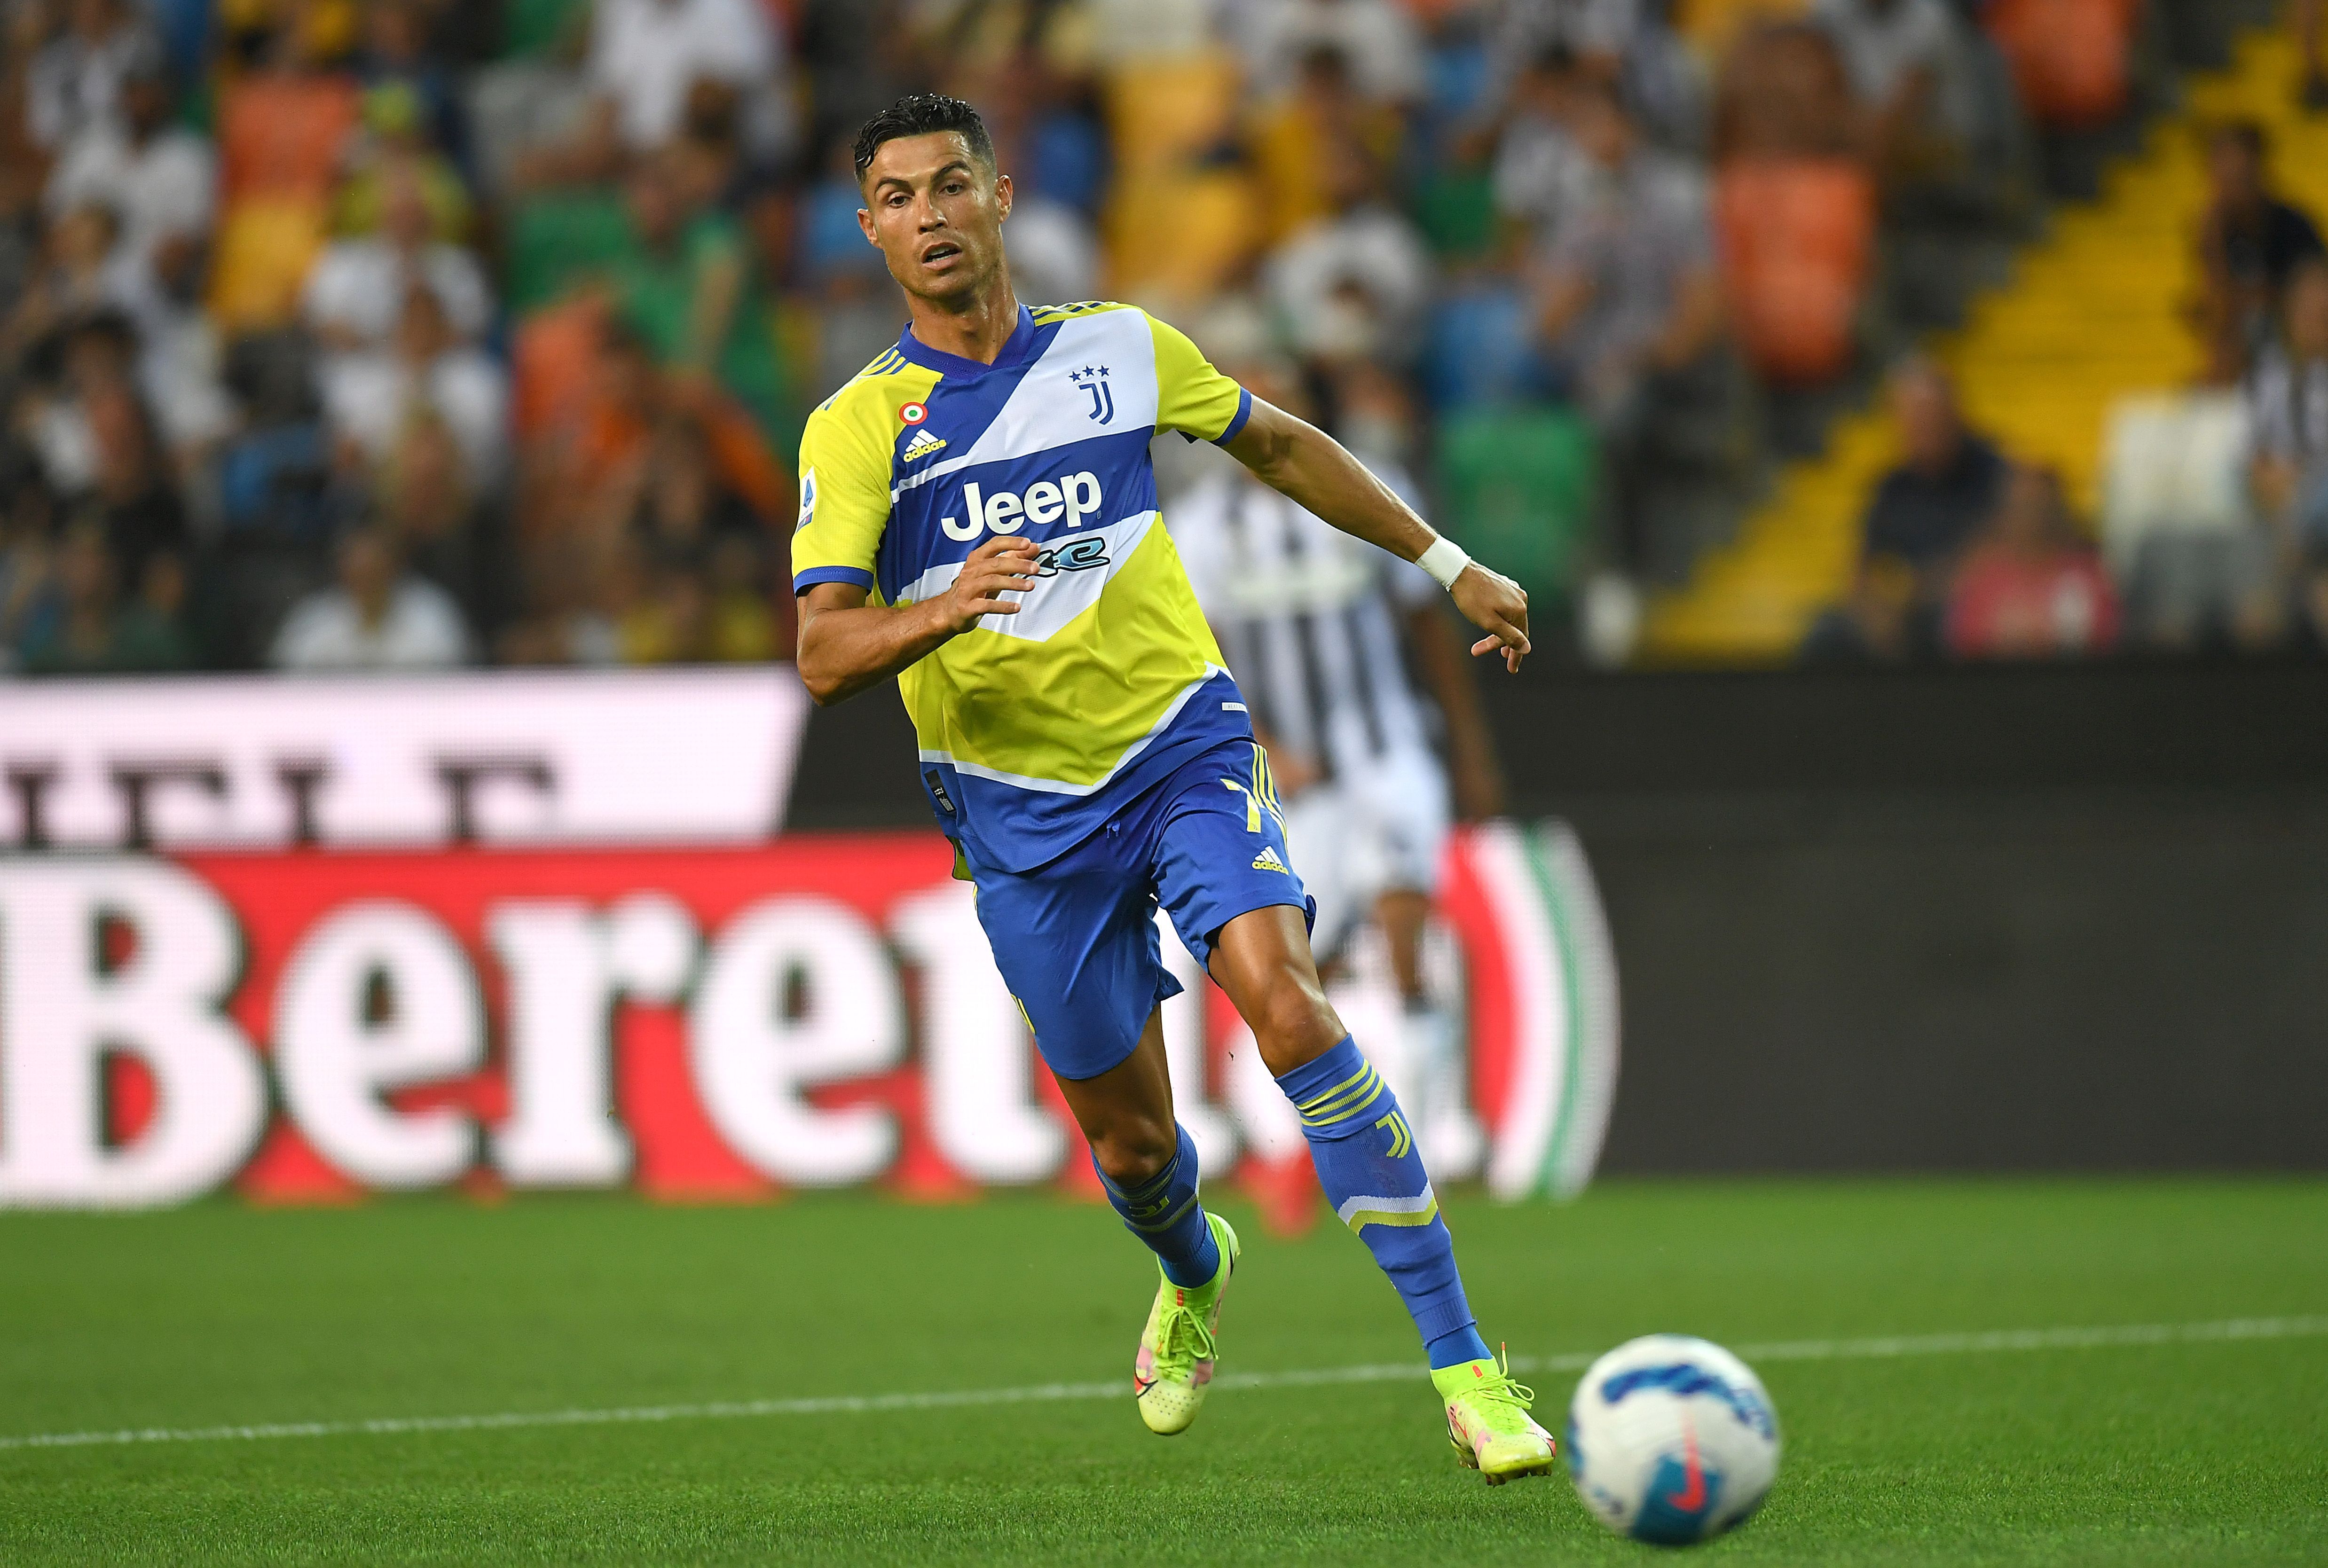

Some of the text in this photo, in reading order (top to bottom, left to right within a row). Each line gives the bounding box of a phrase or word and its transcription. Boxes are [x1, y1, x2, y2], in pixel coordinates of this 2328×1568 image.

[904, 439, 947, 463] adidas
[941, 471, 1102, 541] Jeep
[1251, 859, 1289, 875] adidas
